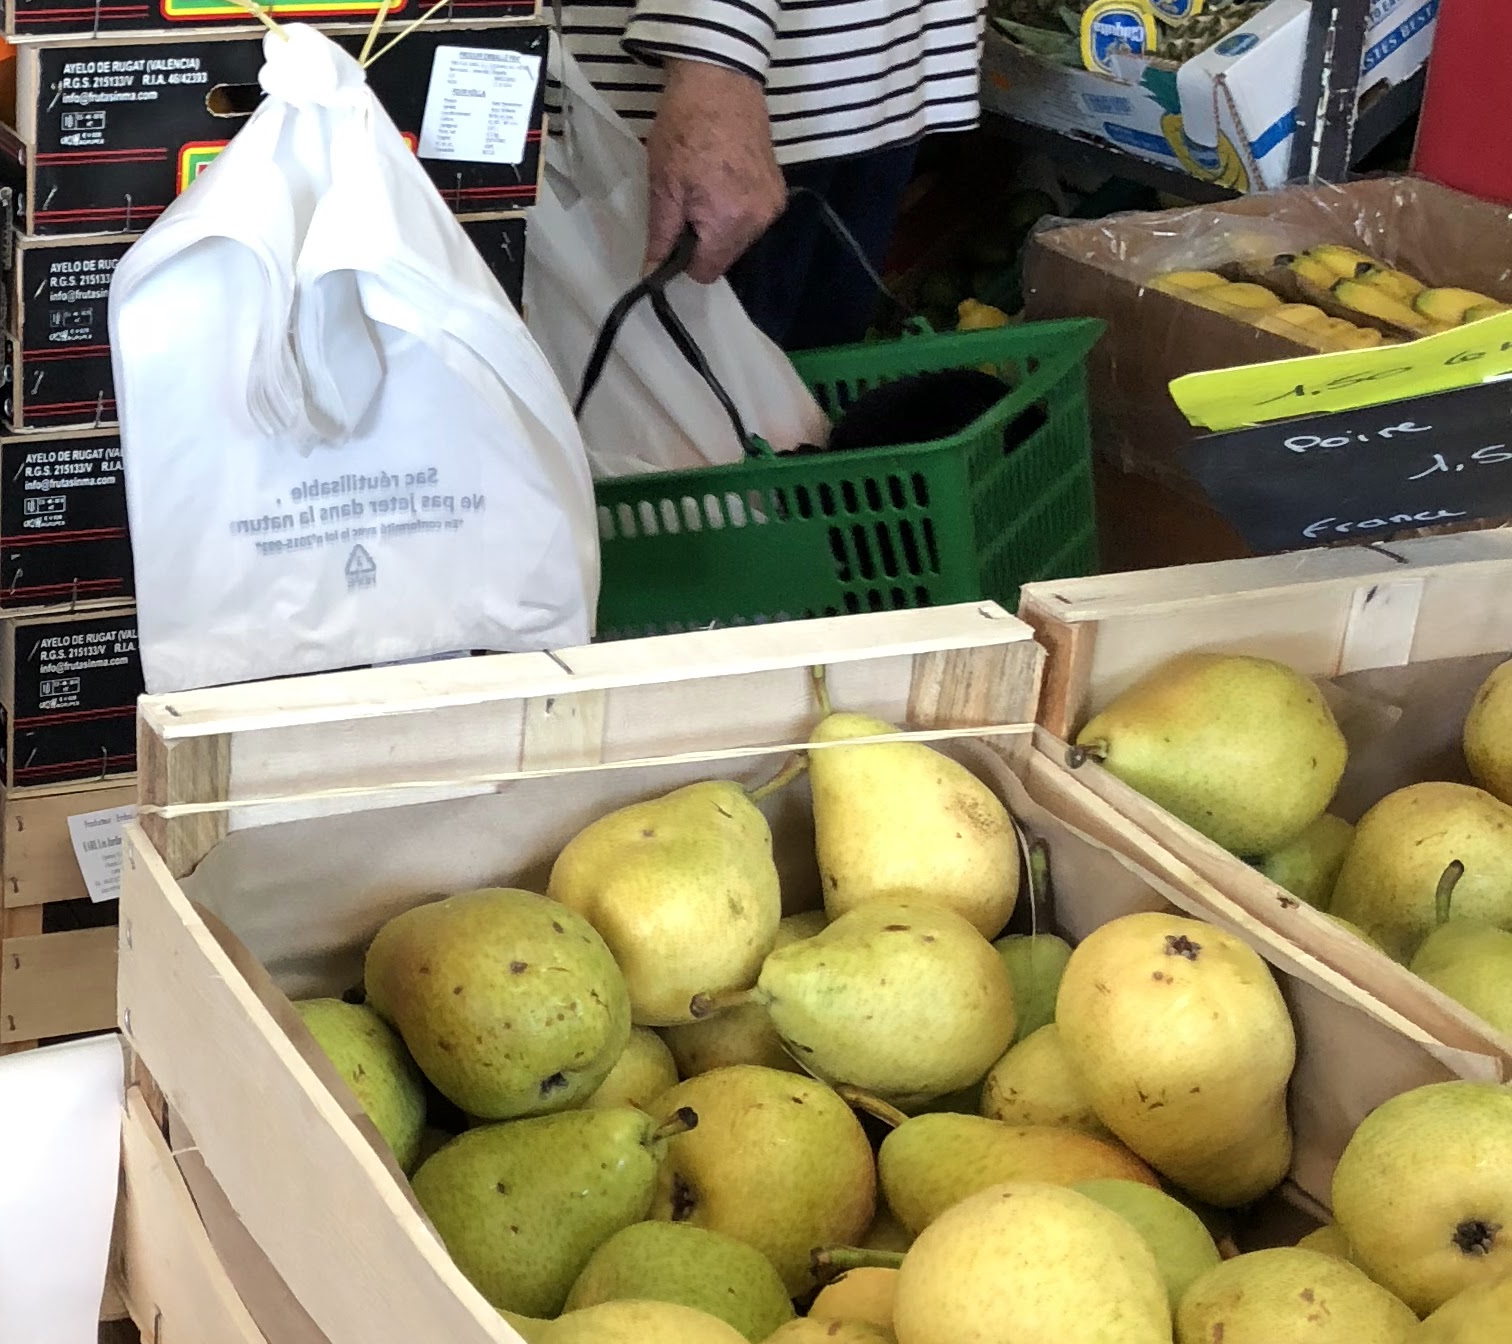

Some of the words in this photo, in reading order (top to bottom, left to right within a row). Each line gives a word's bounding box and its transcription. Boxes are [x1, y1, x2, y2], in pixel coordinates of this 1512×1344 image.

[63, 61, 95, 74] AYELO
[97, 61, 110, 73] DE
[112, 59, 146, 73] RUGAT
[146, 58, 200, 73] (VALENCIA)
[93, 76, 134, 88] 215133/V
[62, 90, 158, 106] info@frutasinma.com
[83, 260, 97, 271] DE
[97, 258, 118, 270] RUG
[79, 274, 110, 286] 215133
[49, 288, 109, 303] info@frutasin
[1254, 365, 1412, 406] 1.50
[1284, 419, 1433, 454] Poire
[57, 450, 71, 462] DE
[1301, 508, 1467, 537] France
